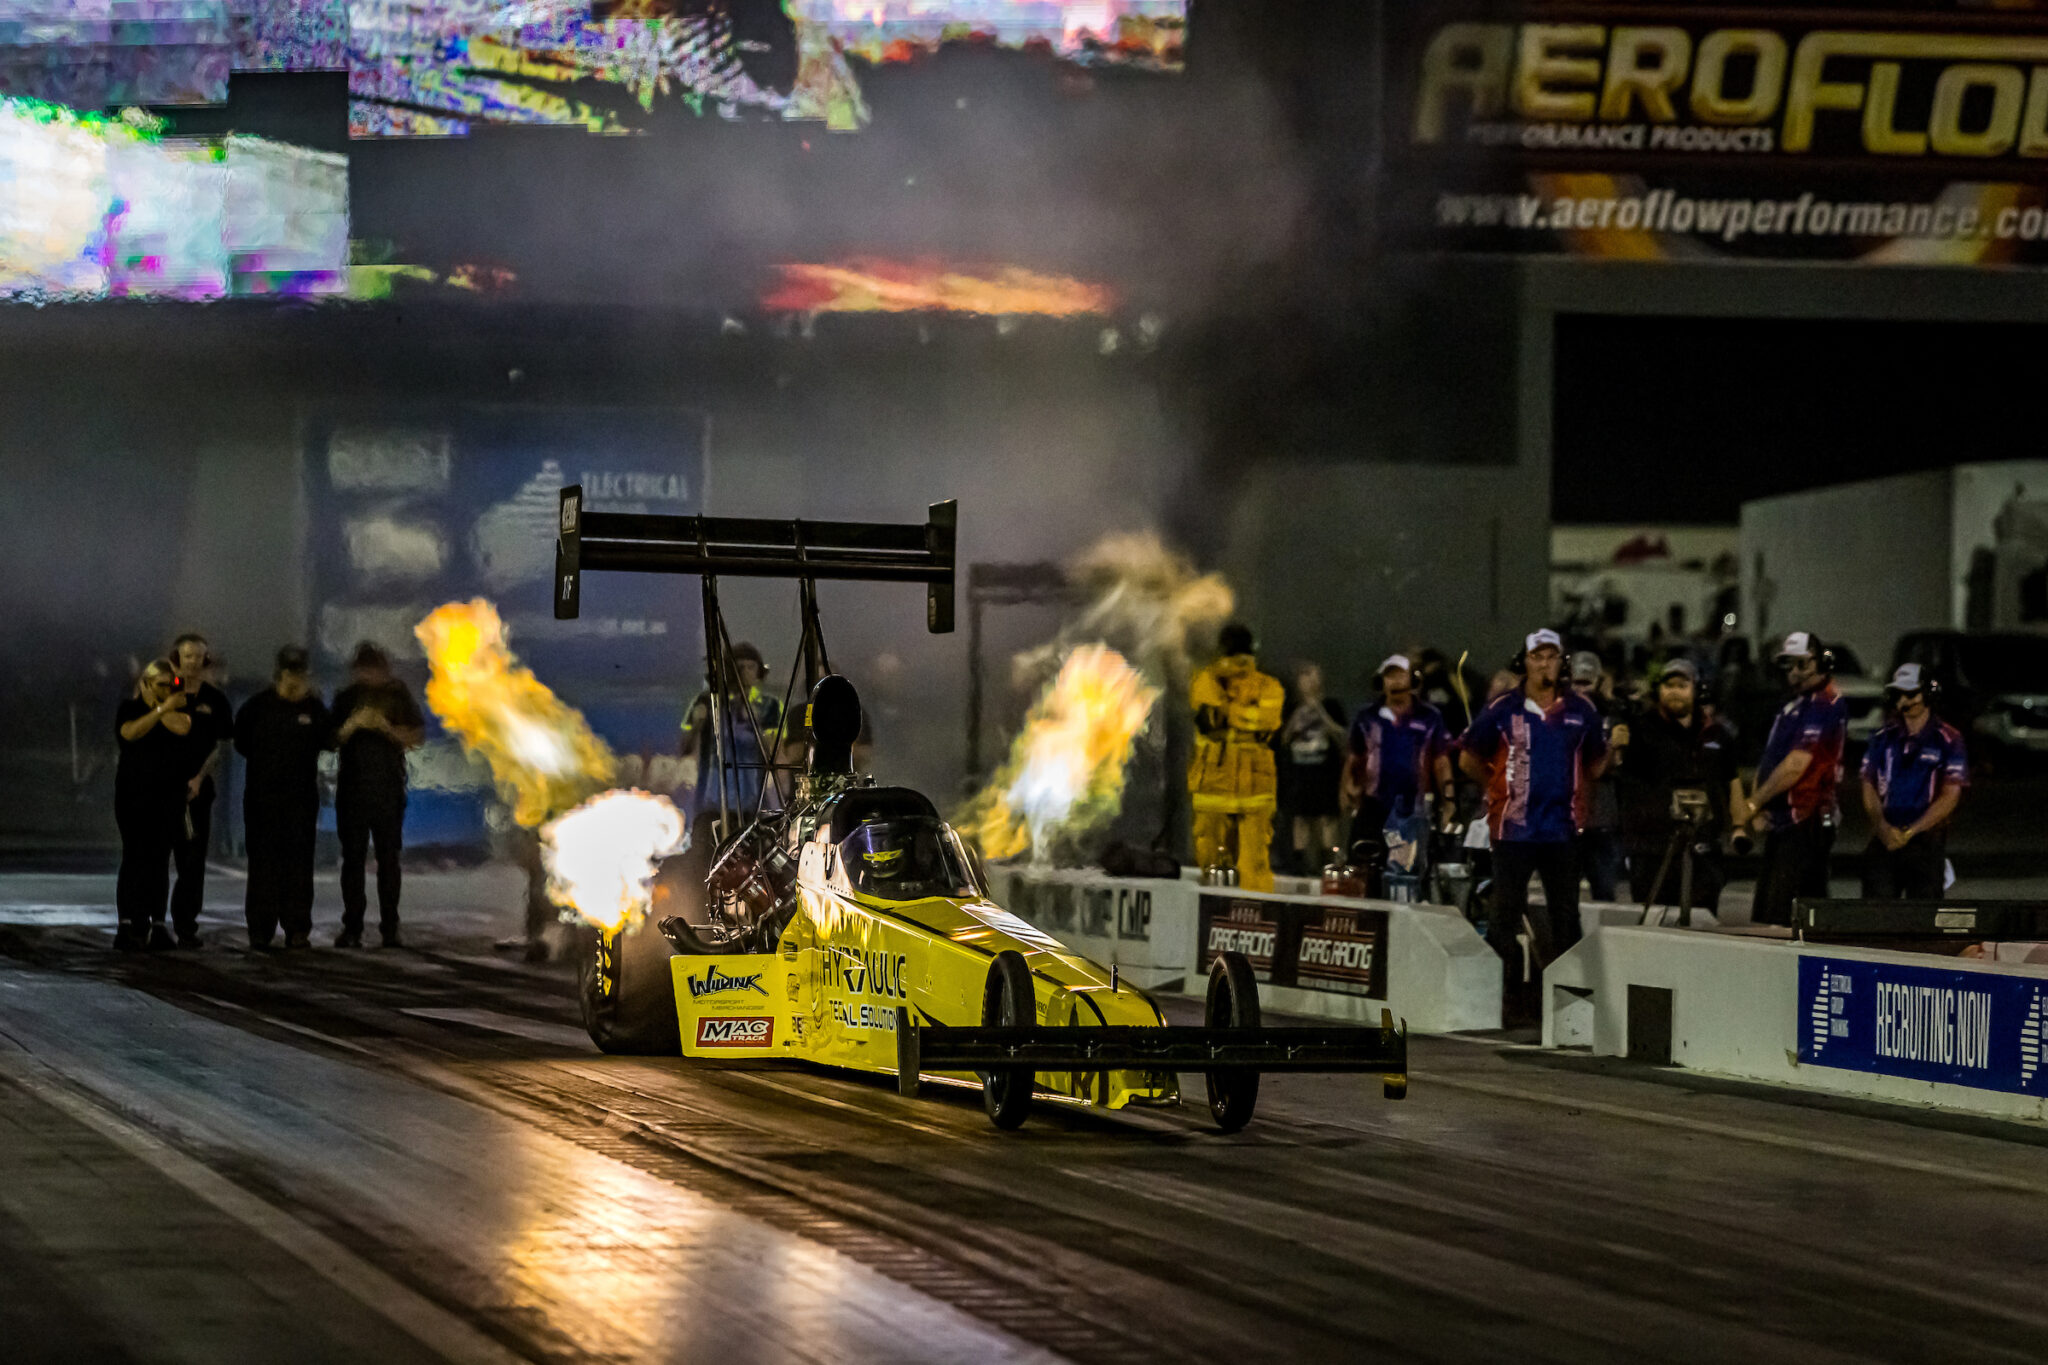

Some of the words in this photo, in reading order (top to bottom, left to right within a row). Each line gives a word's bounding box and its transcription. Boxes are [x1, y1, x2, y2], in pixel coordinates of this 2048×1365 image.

[1650, 125, 1774, 153] PRODUCTS
[1436, 188, 2048, 241] www.aeroflowperformance.co
[1207, 926, 1239, 952] DRAG
[1299, 937, 1332, 965] DRAG
[1876, 981, 1954, 1065] RECRUITING
[1956, 990, 1991, 1069] NOW
